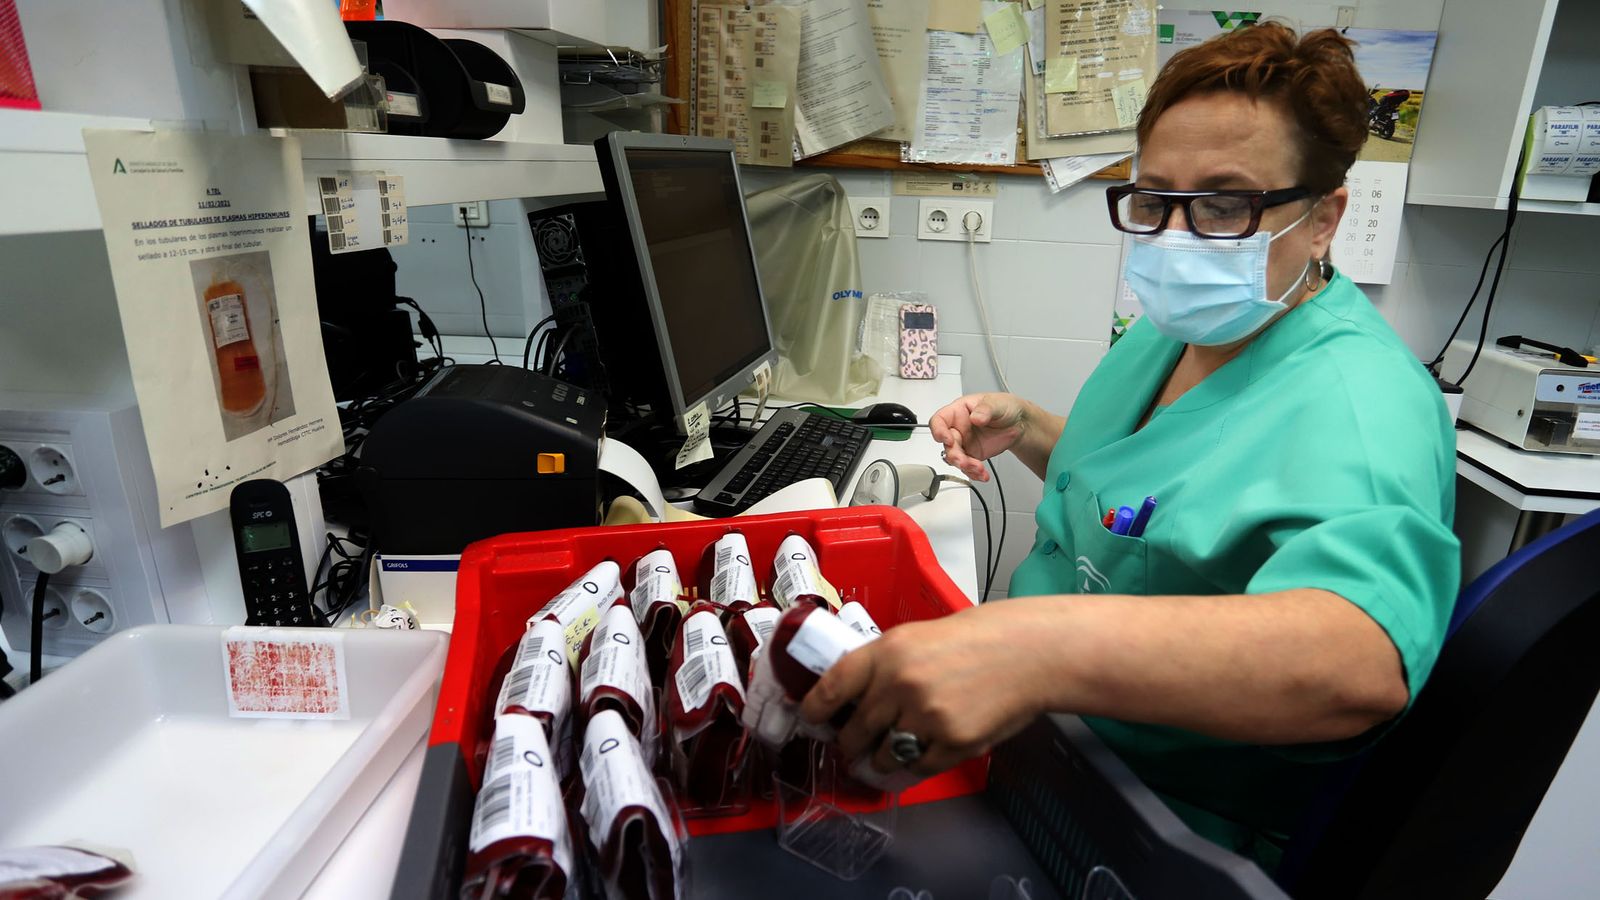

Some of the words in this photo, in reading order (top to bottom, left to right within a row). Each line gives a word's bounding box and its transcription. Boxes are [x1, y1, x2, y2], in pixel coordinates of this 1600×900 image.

[1351, 189, 1362, 198] 05
[1371, 190, 1382, 199] 06
[198, 200, 231, 209] 11/02/2021
[1351, 204, 1360, 213] 12
[1370, 205, 1380, 214] 13
[132, 219, 168, 230] SELLADOS
[168, 219, 177, 227] DE
[178, 216, 213, 226] TUBULARES
[213, 216, 221, 224] DE
[222, 214, 247, 223] PLASMAS
[247, 211, 290, 221] HIPERINMUNES
[1349, 218, 1359, 228] 19
[1367, 219, 1378, 229] 20
[134, 238, 145, 247] En
[146, 237, 157, 245] los
[158, 235, 188, 244] tubulares
[1345, 232, 1356, 242] 26
[1365, 233, 1376, 243] 27
[138, 252, 162, 261] sellado
[168, 248, 188, 257] 12-15
[1363, 247, 1374, 257] 04
[252, 511, 265, 519] SPC
